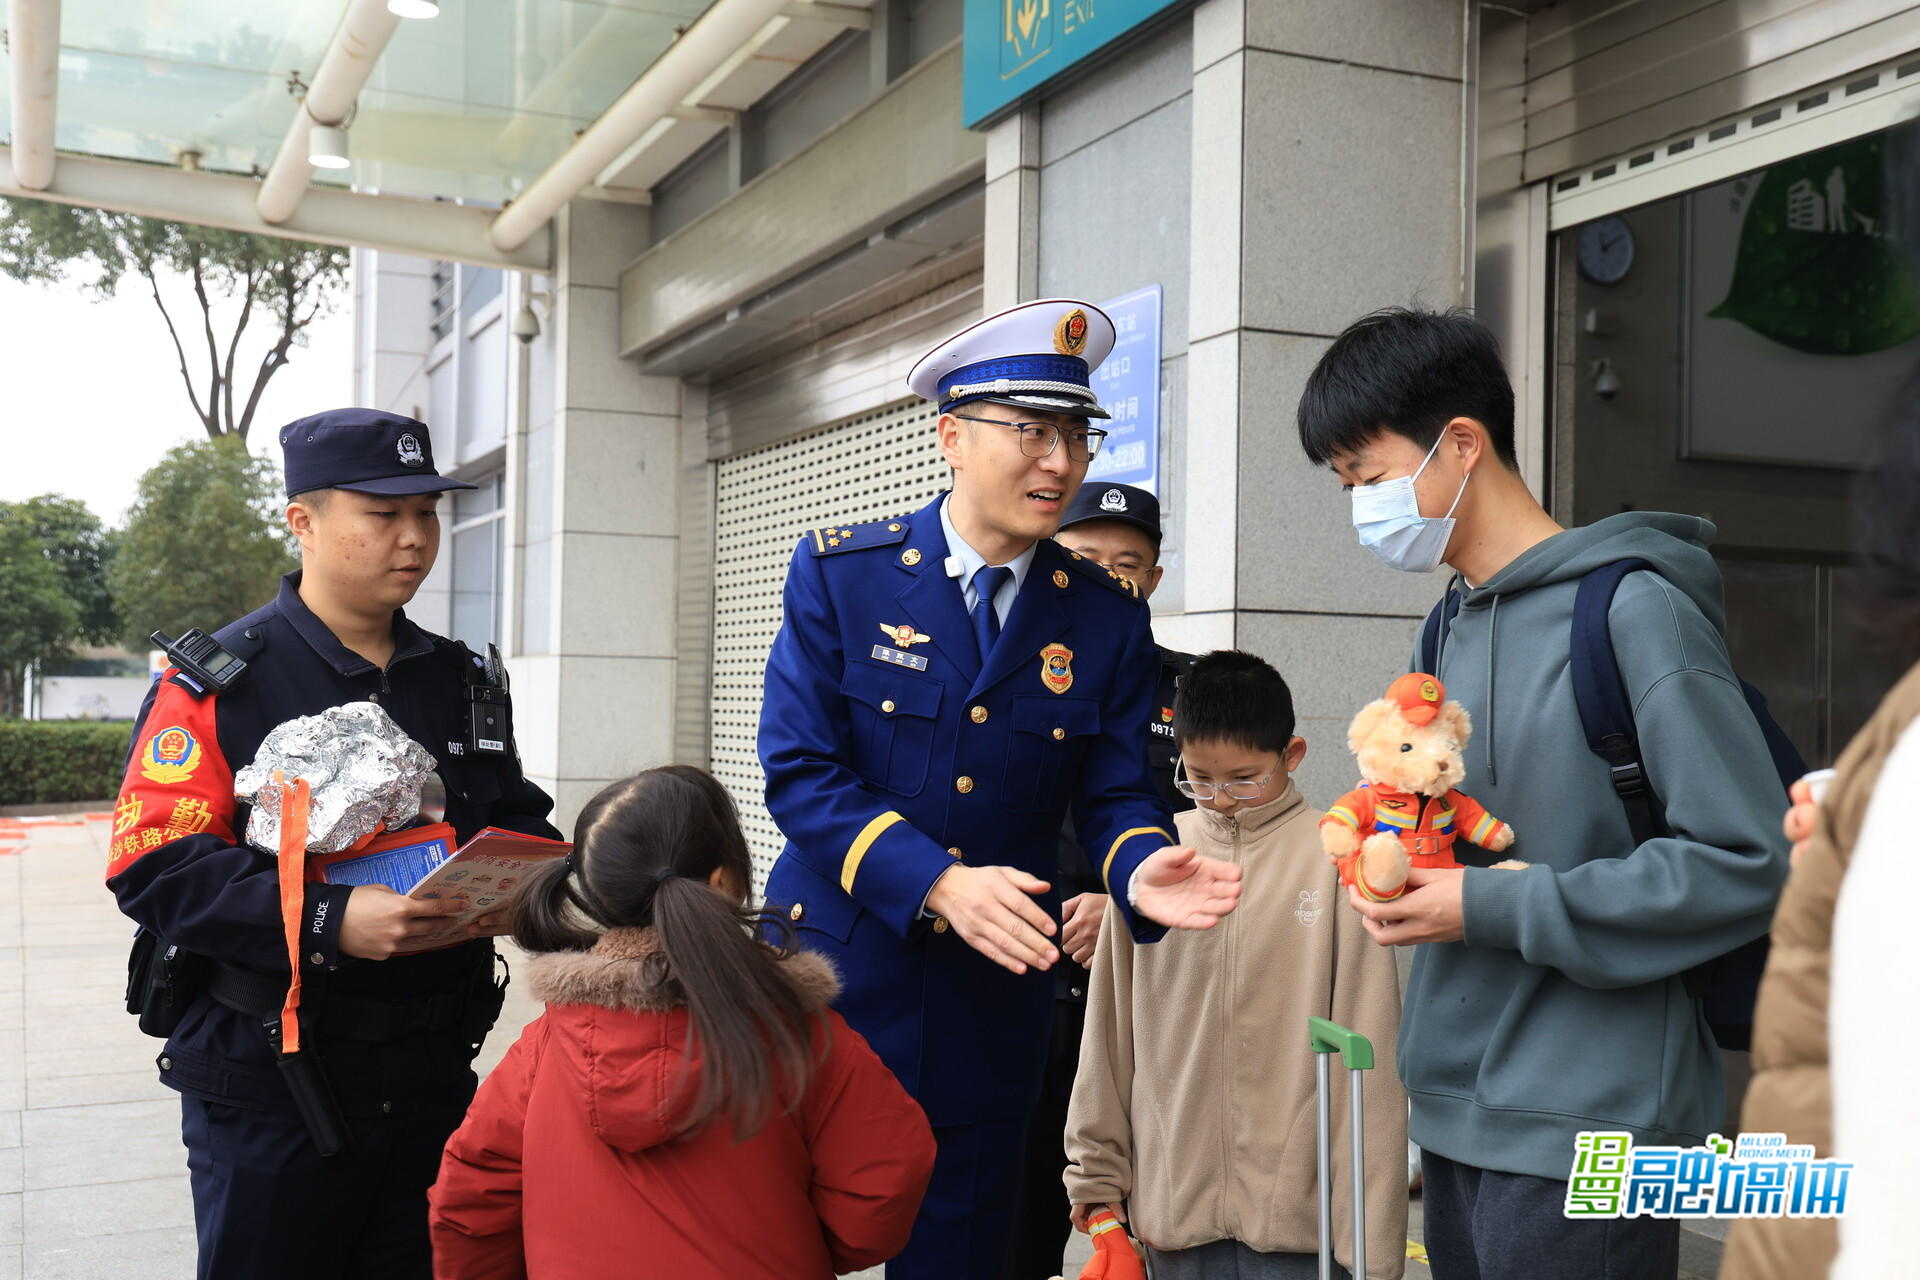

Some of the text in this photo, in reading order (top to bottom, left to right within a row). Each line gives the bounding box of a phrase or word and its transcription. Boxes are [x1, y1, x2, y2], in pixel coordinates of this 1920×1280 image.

[1100, 355, 1131, 382] 出站口
[447, 741, 464, 756] 0975
[312, 899, 330, 934] POLICE
